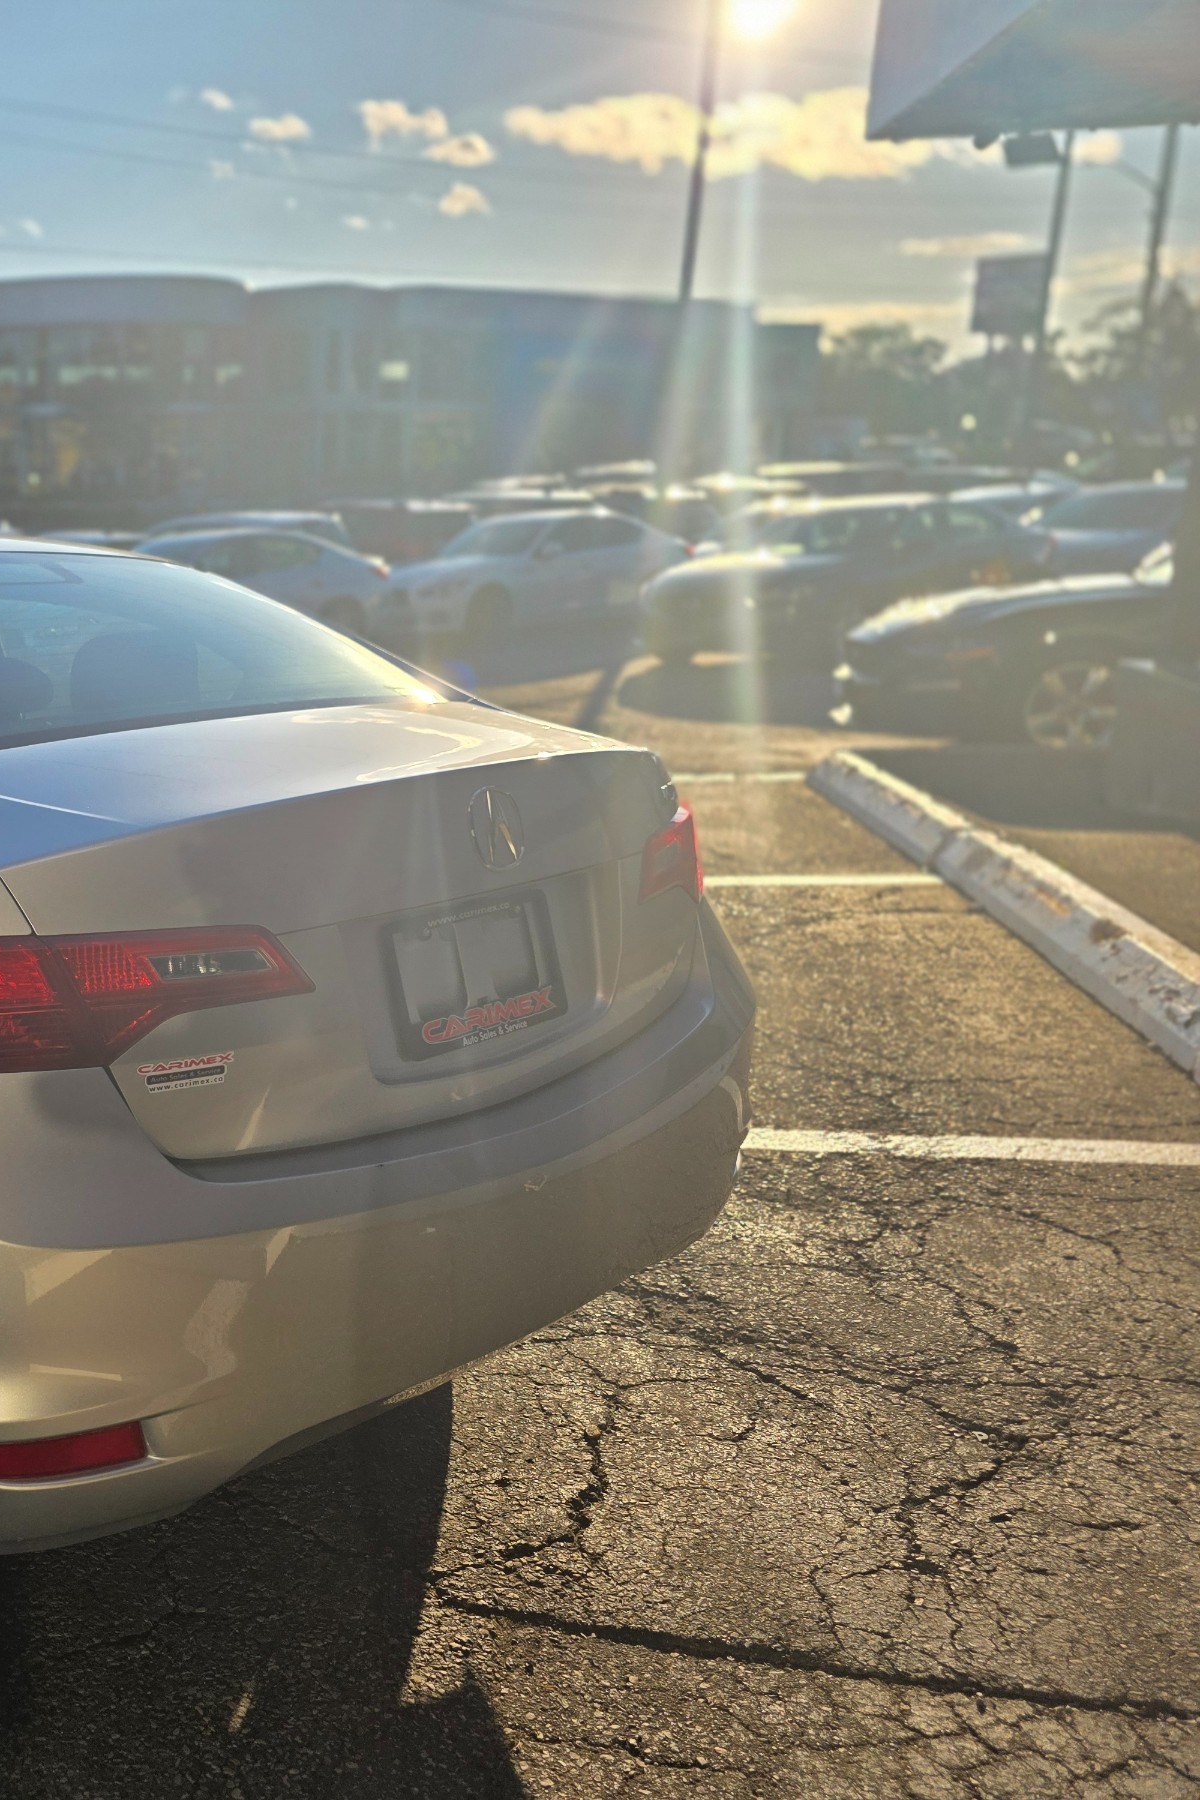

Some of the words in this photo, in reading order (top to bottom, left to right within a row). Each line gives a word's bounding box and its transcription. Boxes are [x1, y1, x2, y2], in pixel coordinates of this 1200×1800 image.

[422, 985, 557, 1044] CARIMEX
[462, 1033, 479, 1047] Auto
[479, 1029, 497, 1041] Sales
[498, 1026, 504, 1035] &
[504, 1019, 528, 1033] Service
[137, 1051, 234, 1075] CARIMEX
[169, 1073, 188, 1081] Sales
[196, 1067, 222, 1076] Service
[148, 1076, 224, 1093] www.carimex.ca
